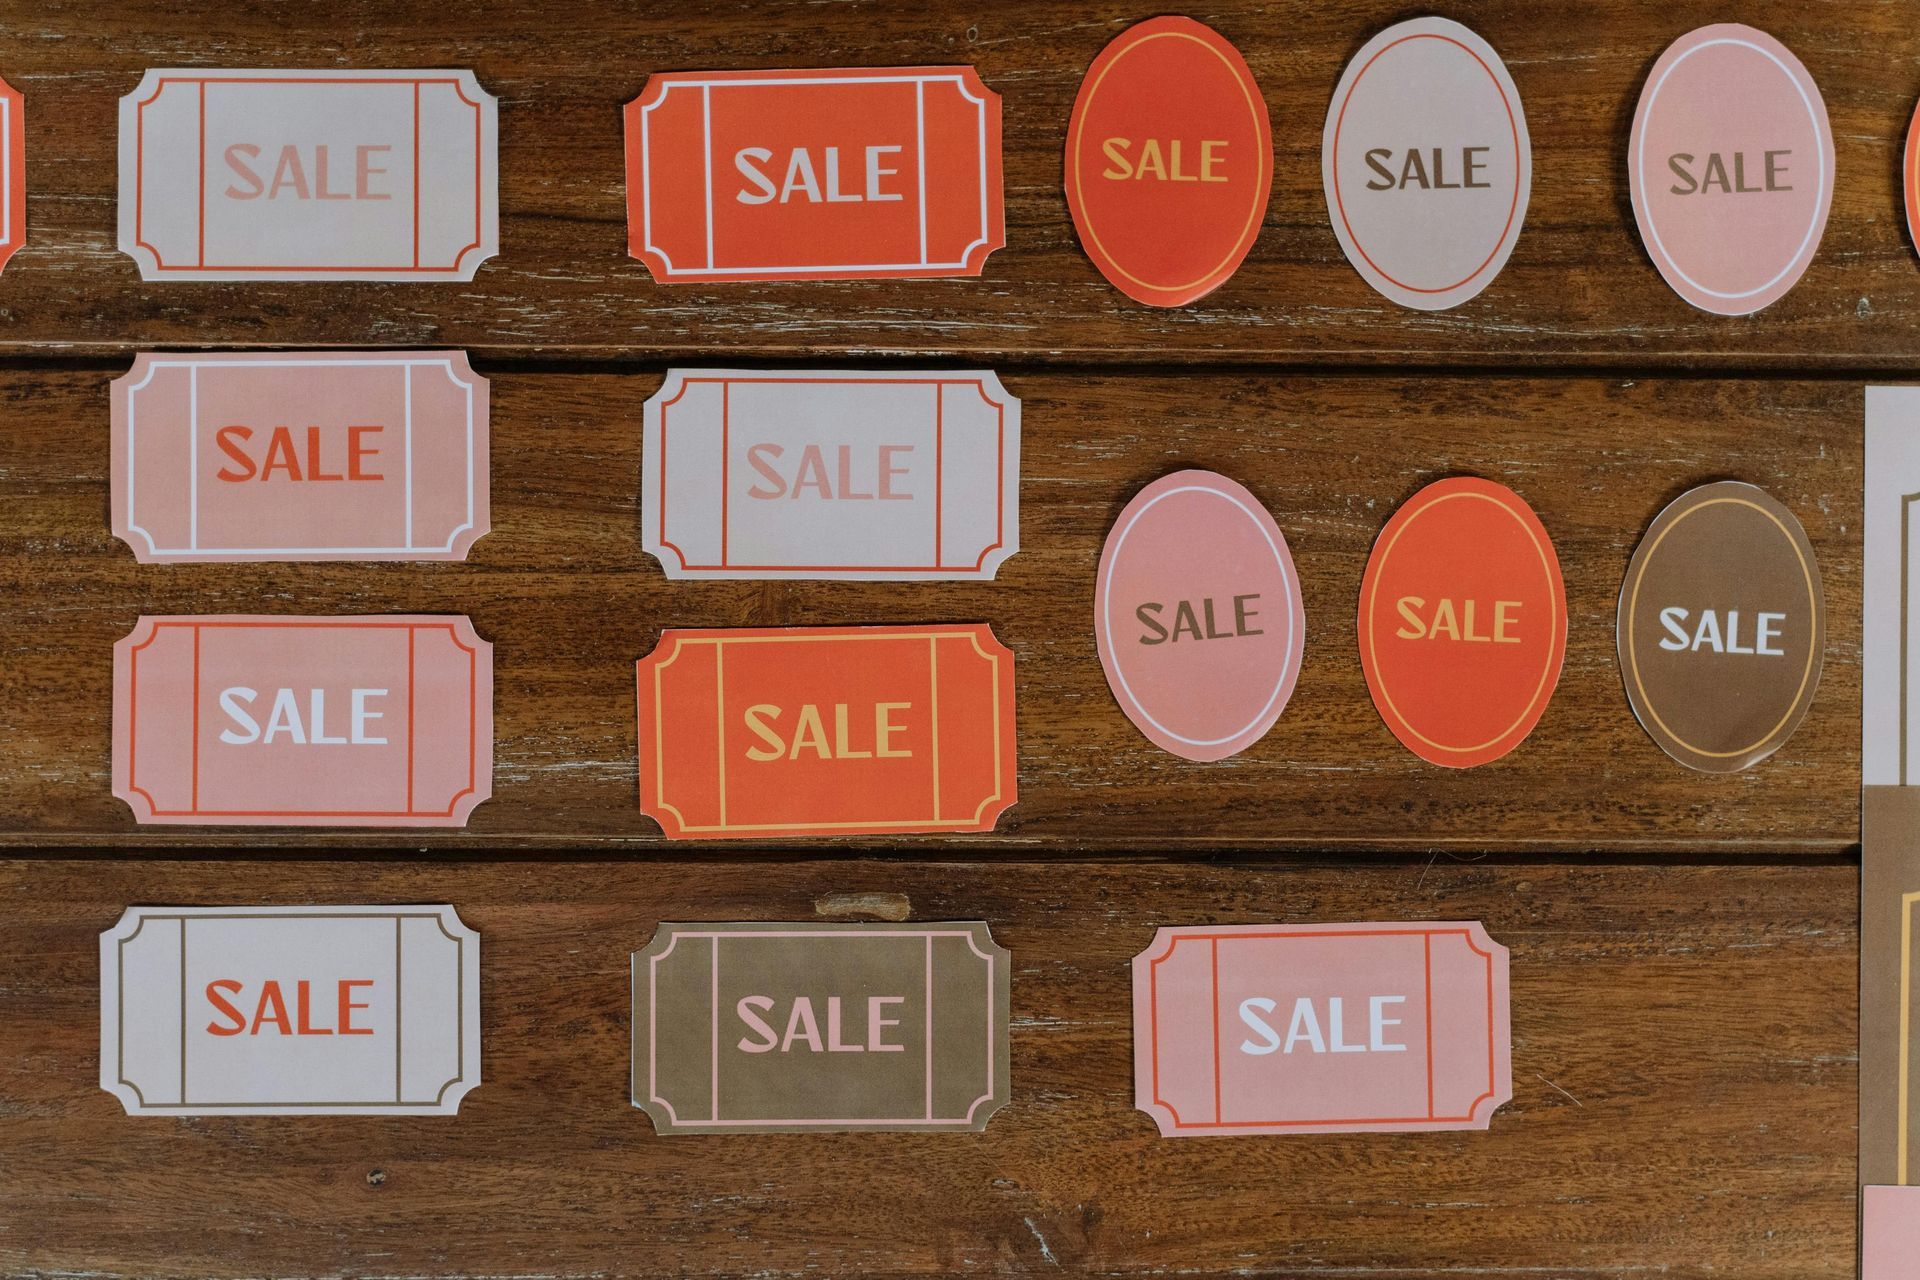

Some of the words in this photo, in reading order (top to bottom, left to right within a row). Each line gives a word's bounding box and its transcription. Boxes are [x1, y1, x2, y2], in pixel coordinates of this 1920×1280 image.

[224, 144, 391, 200] SALE
[735, 145, 903, 204] SALE
[1103, 138, 1228, 182] SALE
[1365, 147, 1490, 191] SALE
[1668, 150, 1792, 195] SALE
[216, 426, 384, 482] SALE
[747, 443, 914, 500] SALE
[1136, 594, 1263, 645] SALE
[1397, 596, 1522, 643] SALE
[1659, 607, 1786, 655] SALE
[220, 687, 388, 744] SALE
[744, 702, 912, 761] SALE
[206, 980, 373, 1036] SALE
[737, 996, 904, 1053] SALE
[1239, 996, 1406, 1055] SALE
